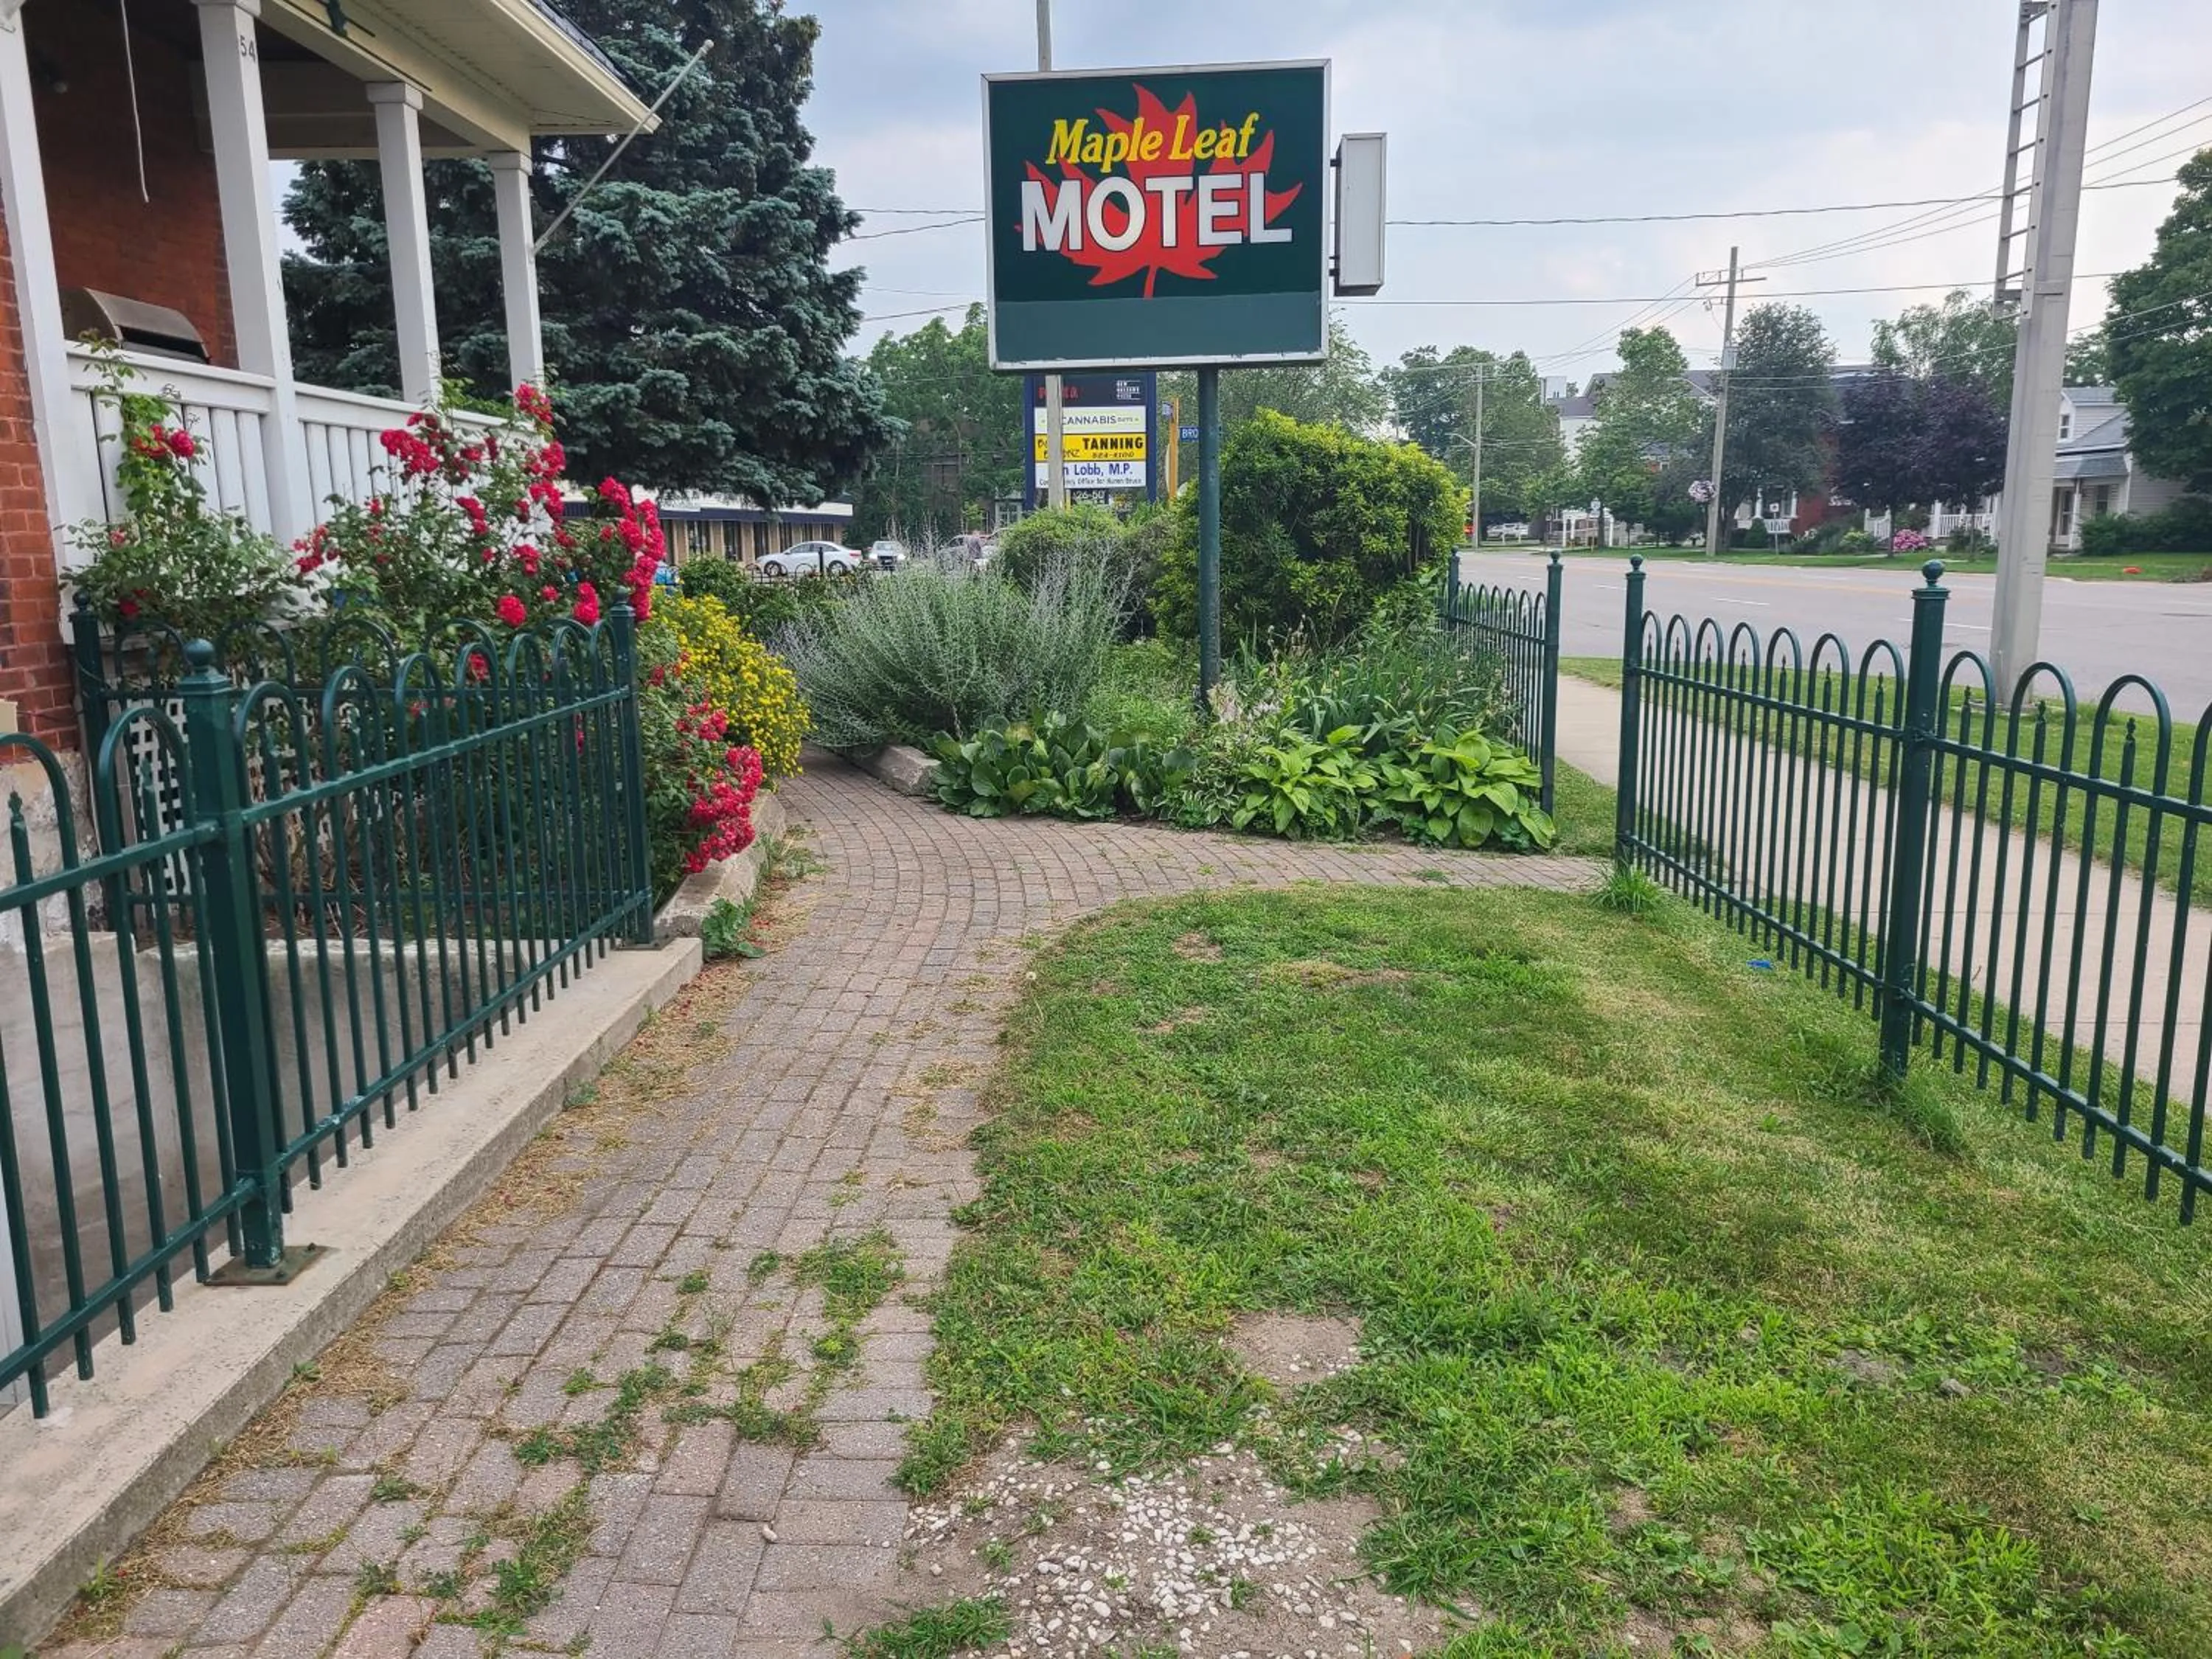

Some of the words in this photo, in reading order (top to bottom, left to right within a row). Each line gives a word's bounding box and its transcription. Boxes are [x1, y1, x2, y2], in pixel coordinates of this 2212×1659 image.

[240, 35, 256, 63] 54
[1046, 116, 1163, 173] Maple
[1168, 112, 1260, 161] Leaf
[1020, 171, 1293, 251] MOTEL
[1062, 415, 1116, 425] CANNABIS
[1182, 428, 1198, 439] BRO
[1082, 437, 1144, 451] TANNING
[1074, 462, 1104, 476] Lobb,
[1108, 462, 1133, 475] M.P.
